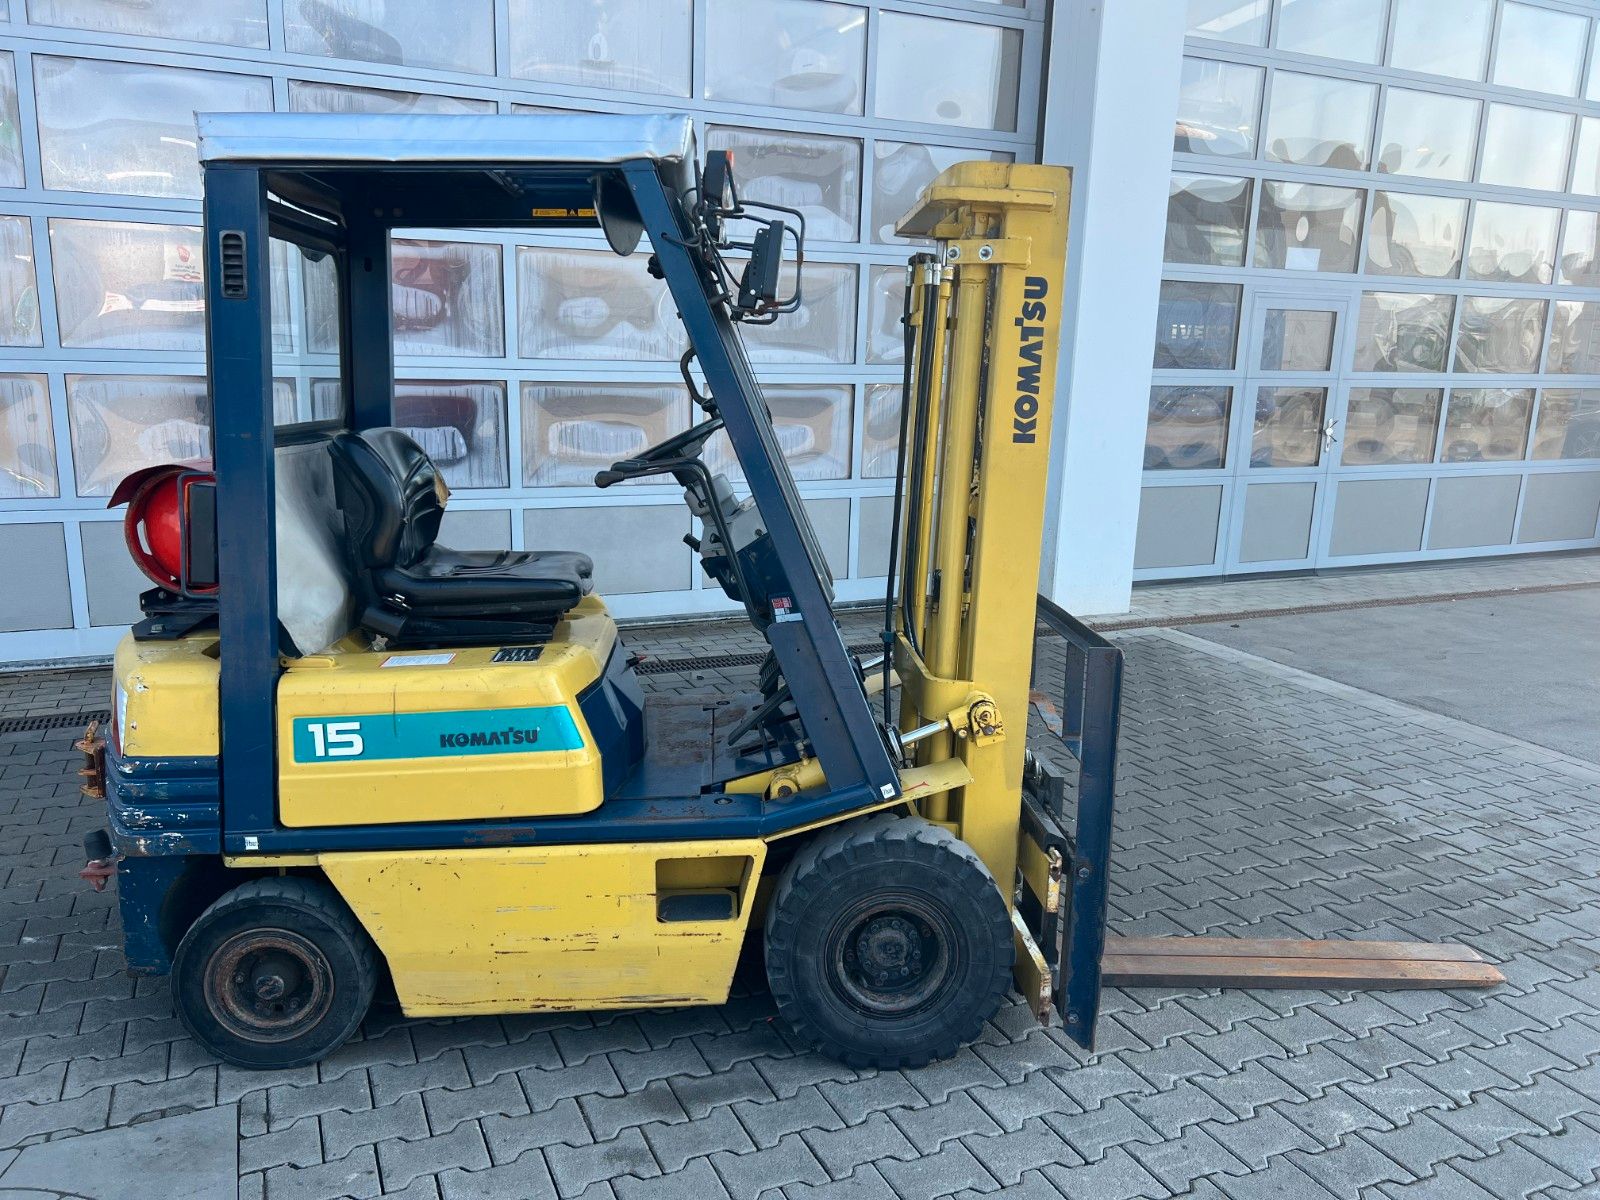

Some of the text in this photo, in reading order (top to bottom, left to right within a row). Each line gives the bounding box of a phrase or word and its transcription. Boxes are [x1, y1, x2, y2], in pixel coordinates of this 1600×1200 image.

[1012, 276, 1048, 443] KOMATSU
[307, 721, 363, 757] 15
[439, 727, 538, 748] KOMATSU
